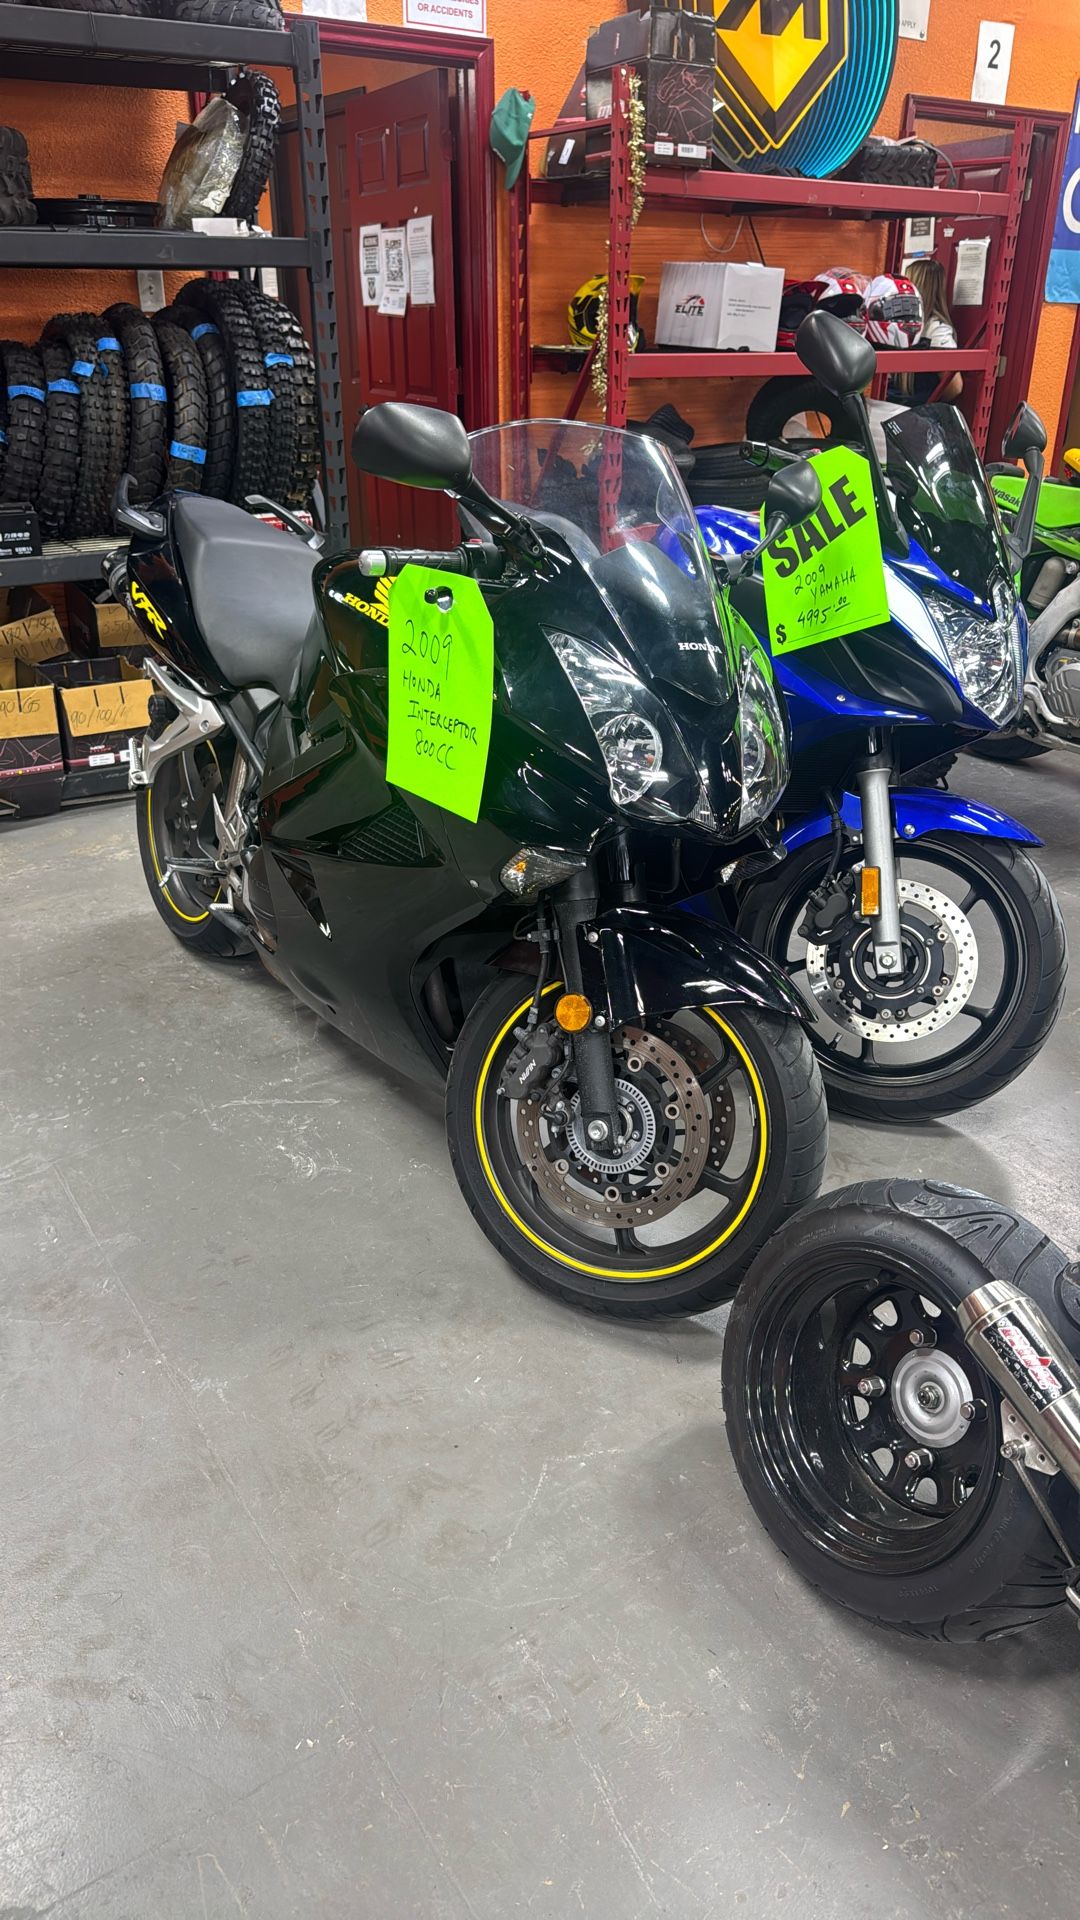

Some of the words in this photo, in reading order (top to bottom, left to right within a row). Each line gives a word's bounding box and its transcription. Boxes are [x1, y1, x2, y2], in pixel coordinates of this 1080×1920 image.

[417, 3, 430, 13] OR
[430, 5, 474, 19] ACCIDENTS
[901, 19, 916, 29] APPLY
[987, 39, 1001, 69] 2
[674, 304, 705, 317] ELITE
[992, 487, 1021, 507] wasak
[767, 474, 867, 578] SALE
[794, 563, 826, 595] 2009
[810, 566, 857, 601] YAMAHA
[131, 581, 167, 640] VFR
[342, 592, 389, 628] HOND
[401, 619, 453, 680] 2009
[678, 642, 722, 654] HONDA
[775, 623, 787, 645] $
[402, 670, 441, 701] HONDA
[407, 700, 477, 745] INTERCEPTOR
[415, 729, 456, 770] 800CC
